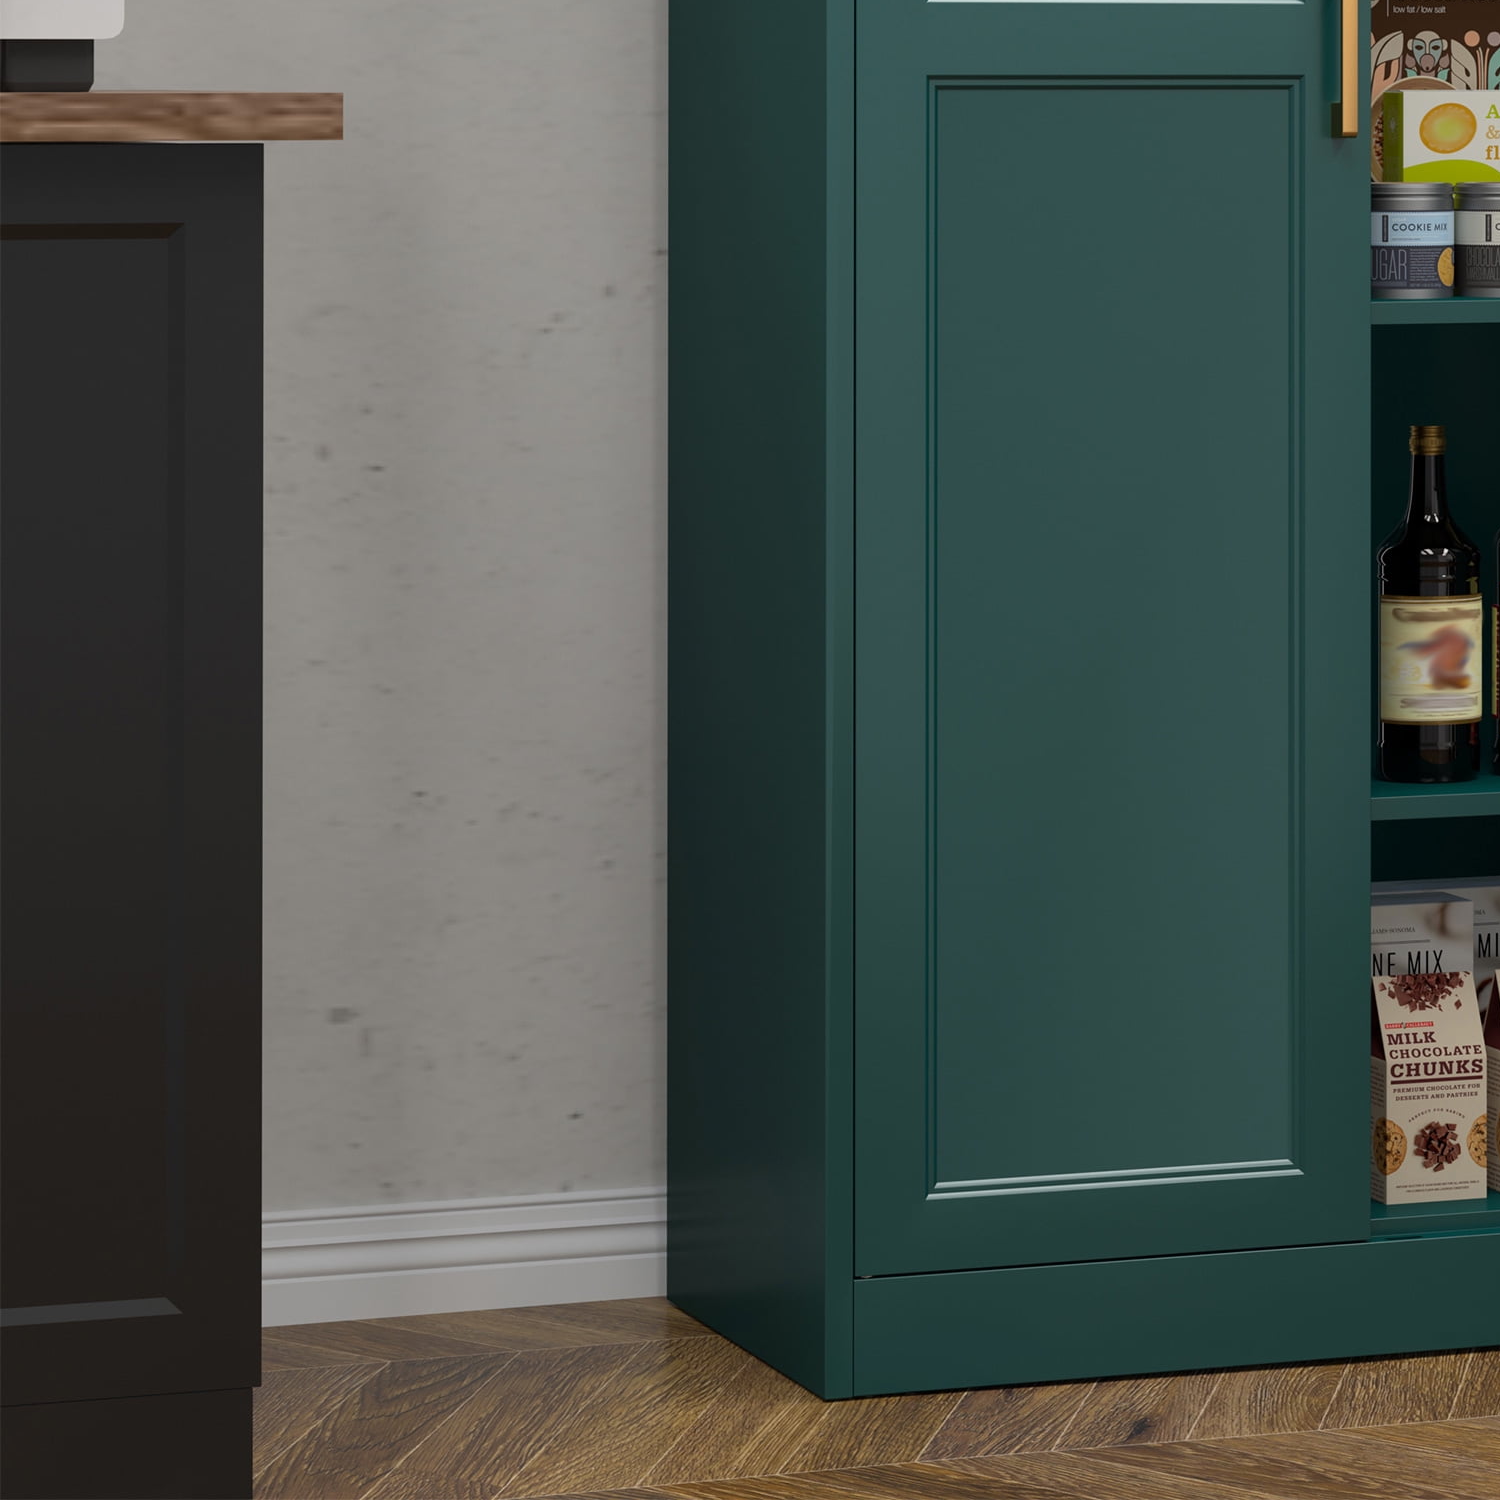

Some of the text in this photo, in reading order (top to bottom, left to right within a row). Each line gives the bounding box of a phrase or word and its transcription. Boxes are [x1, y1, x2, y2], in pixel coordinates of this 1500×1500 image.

[1392, 5, 1405, 14] low
[1406, 5, 1416, 14] fat
[1421, 5, 1433, 14] low
[1434, 5, 1447, 14] salt
[1485, 125, 1500, 140] &
[1392, 223, 1448, 232] COOKIE MIX
[1372, 248, 1408, 280] UGAR
[1407, 949, 1443, 976] MIX
[1386, 1031, 1437, 1046] MILK
[1389, 1044, 1482, 1060] CHOCOLATE
[1390, 1058, 1484, 1078] CHUNKS
[1392, 1085, 1425, 1094] PREMIUM
[1426, 1083, 1466, 1092] CHOCOLATE
[1395, 1091, 1479, 1102] DESSERTS AND PASTRIES
